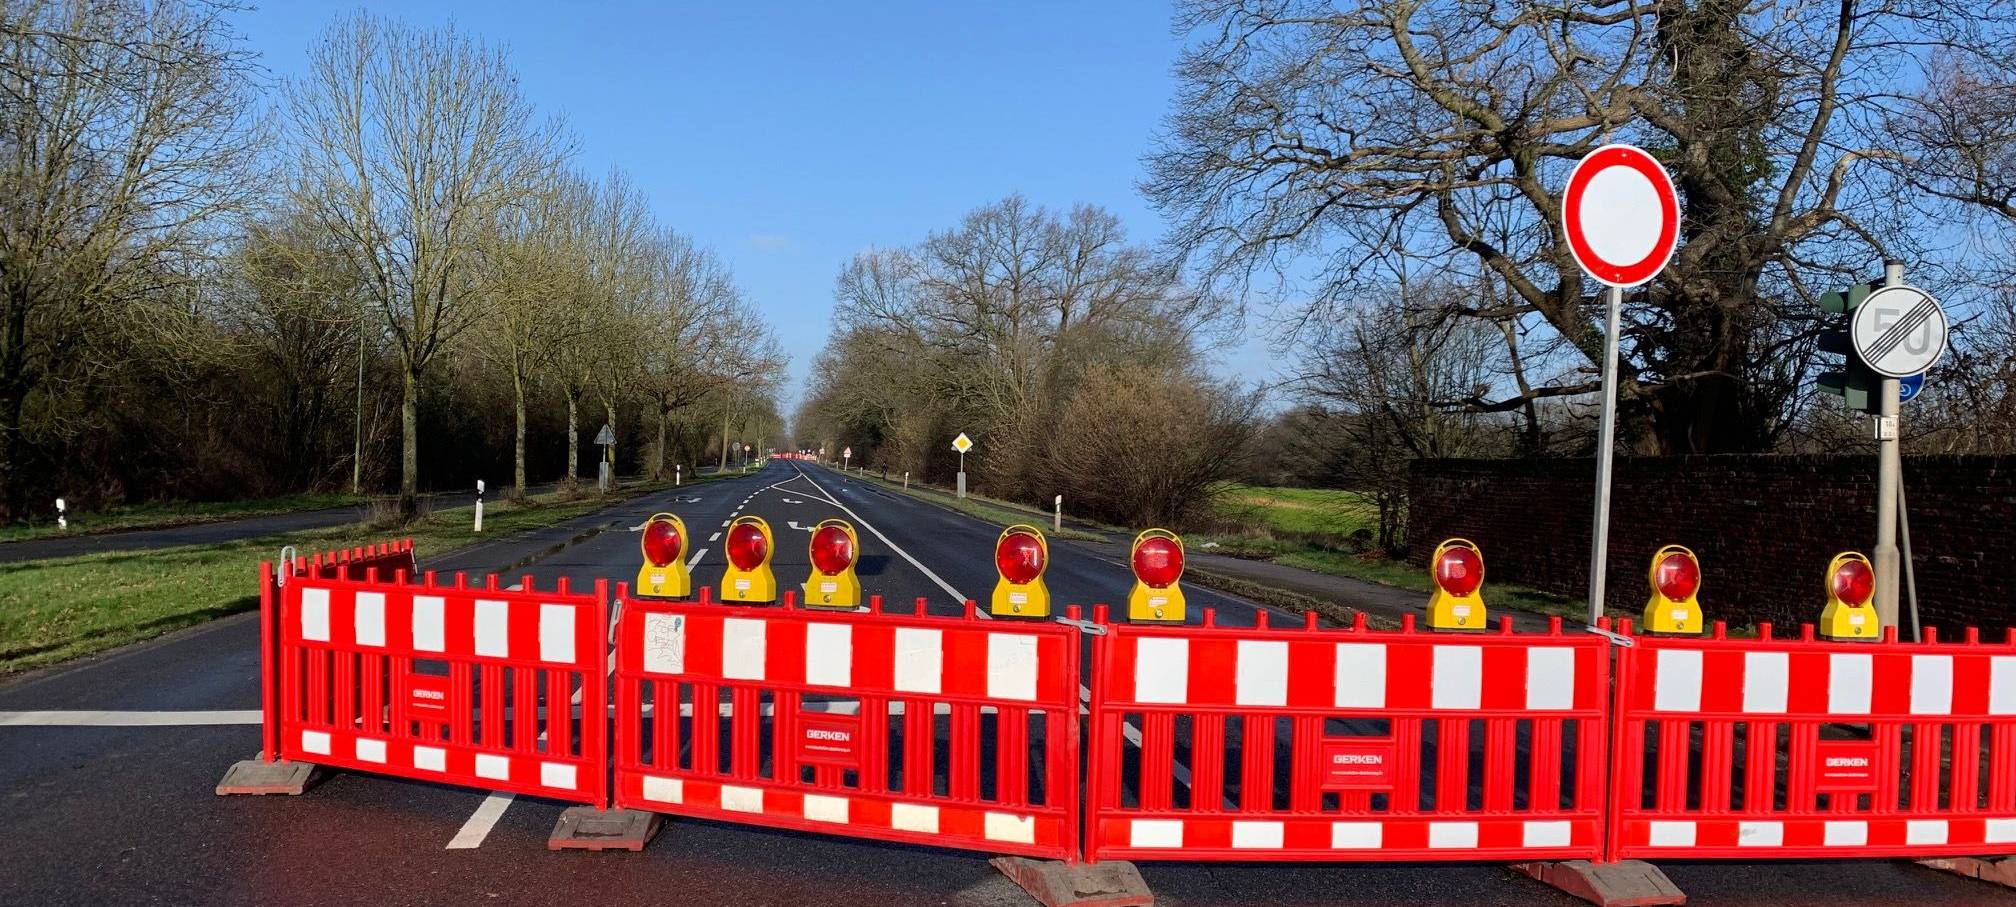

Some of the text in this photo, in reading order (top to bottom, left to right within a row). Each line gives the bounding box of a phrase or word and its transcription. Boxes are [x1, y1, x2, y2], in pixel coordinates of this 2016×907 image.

[1874, 307, 1931, 356] 50
[412, 689, 445, 700] GERKEN
[806, 729, 850, 741] GERKEN
[1333, 754, 1383, 764] GERKEN
[1826, 757, 1868, 767] GERKEN
